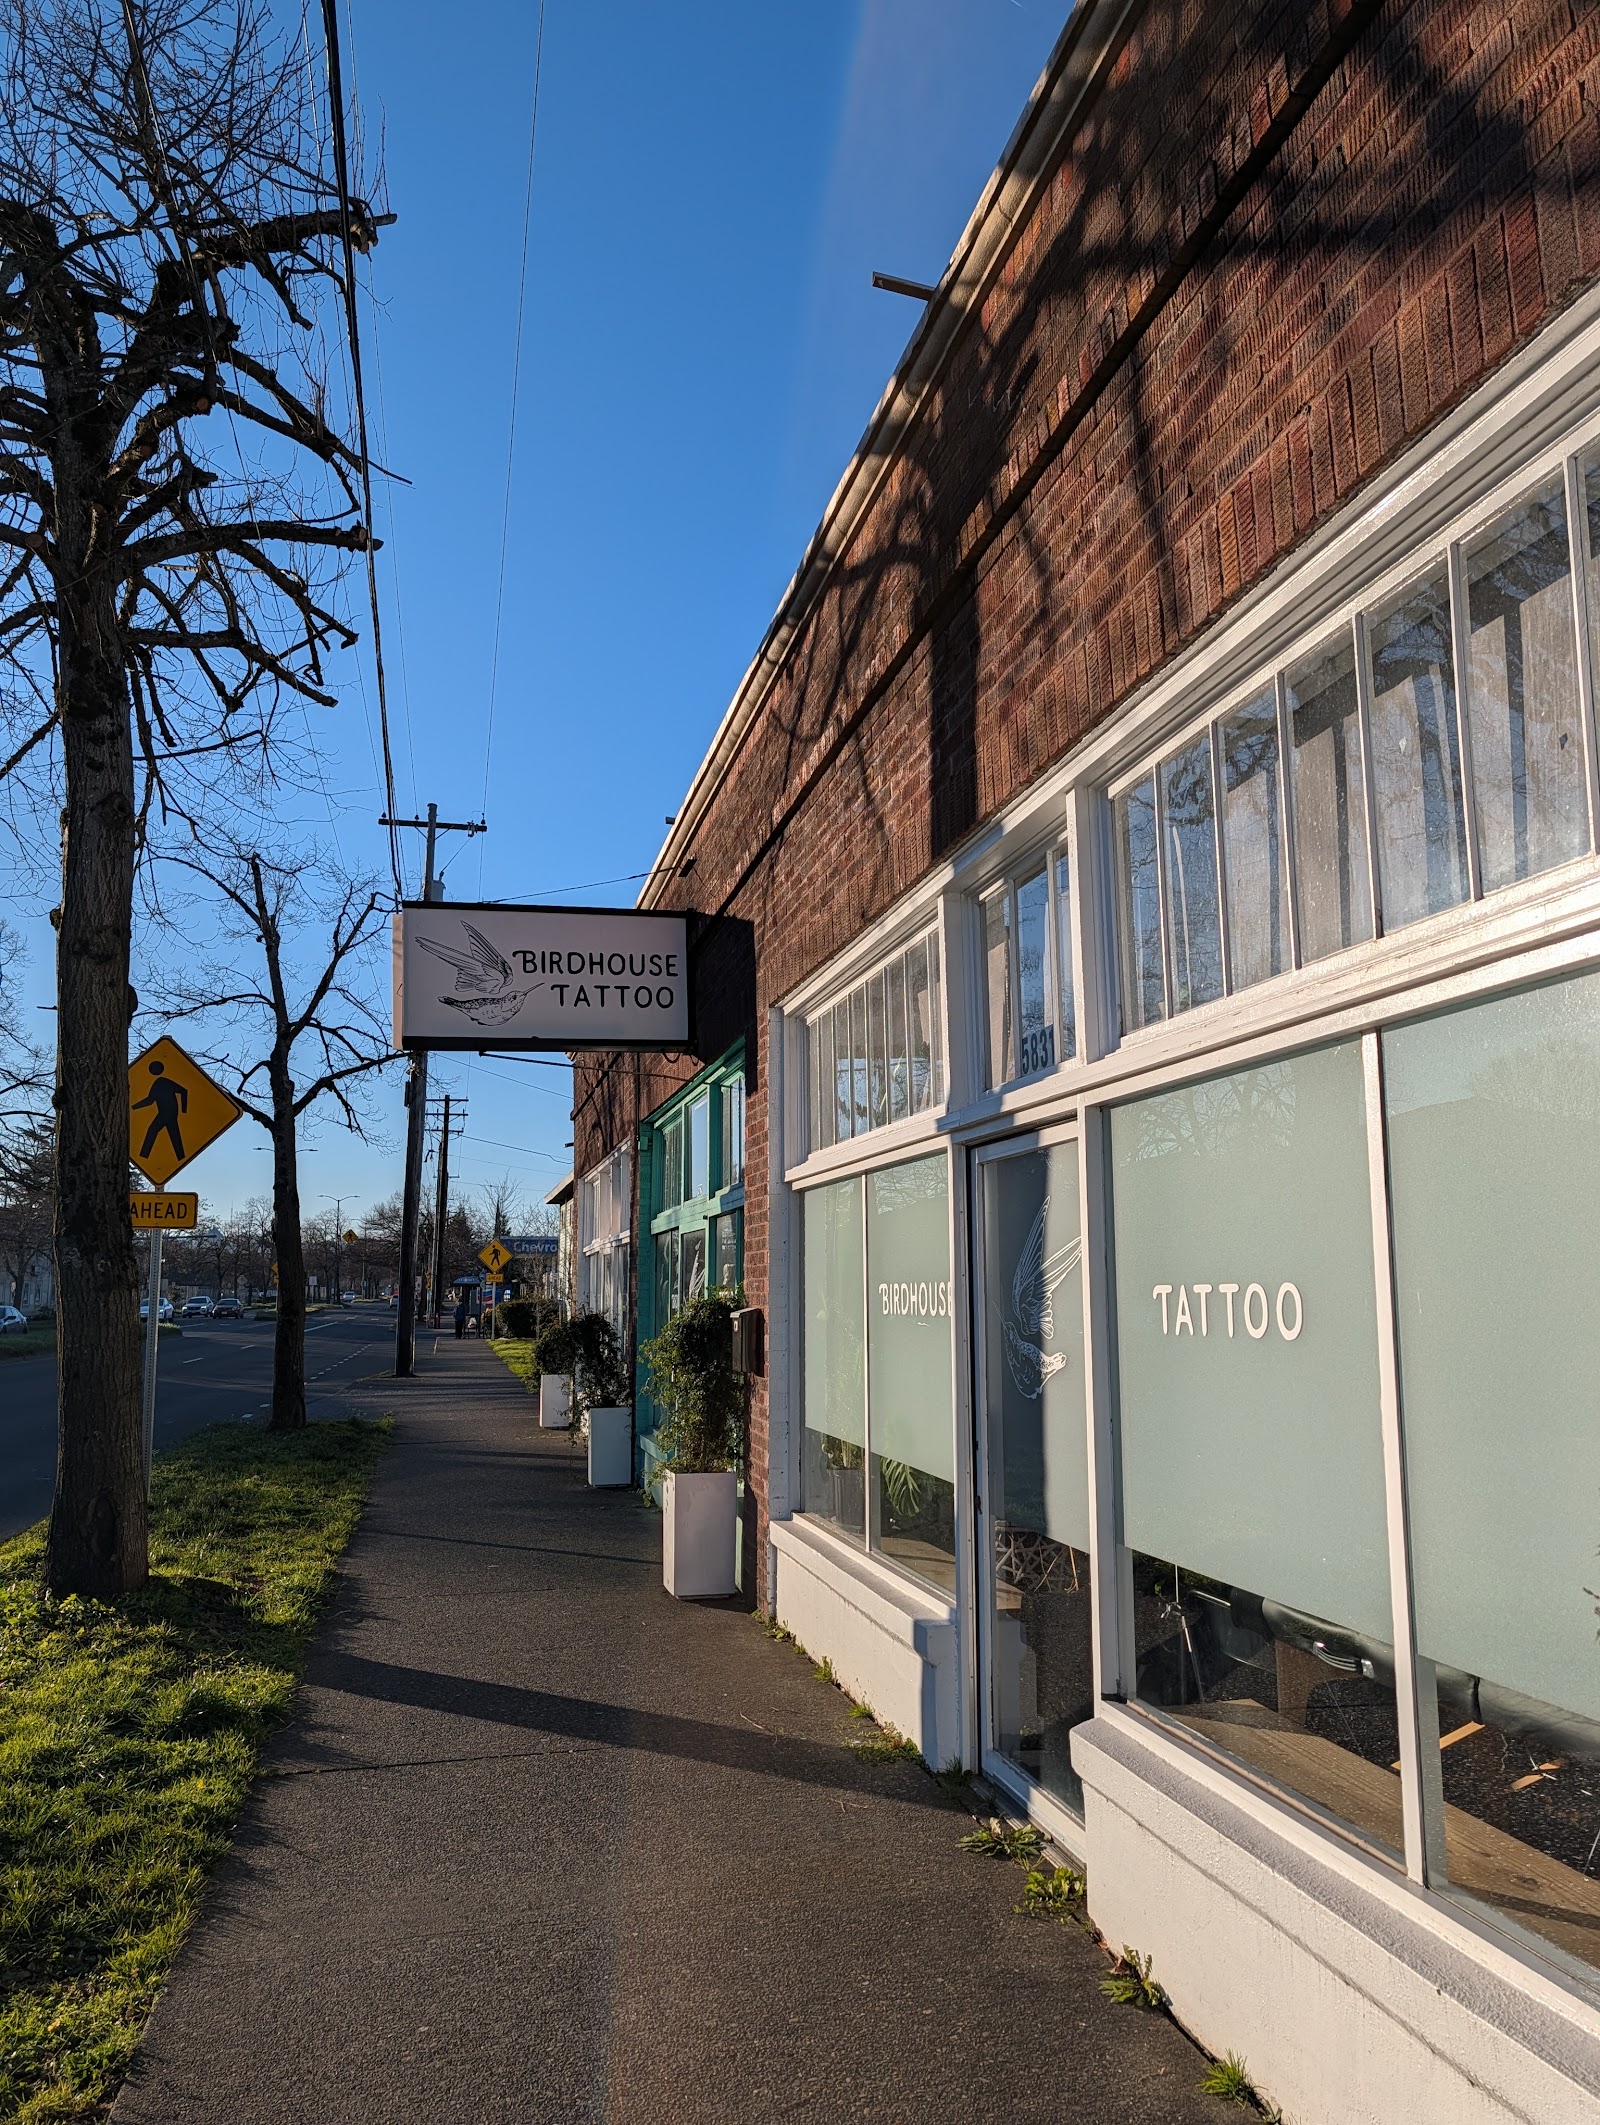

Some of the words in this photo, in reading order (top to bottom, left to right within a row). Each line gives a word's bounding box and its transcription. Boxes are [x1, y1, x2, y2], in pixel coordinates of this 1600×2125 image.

[512, 950, 679, 977] BIRDHOUSE
[550, 984, 674, 1009] TATTOO
[1021, 1026, 1055, 1075] 5831
[130, 1202, 188, 1219] AHEAD
[1152, 1282, 1303, 1341] TATTOO
